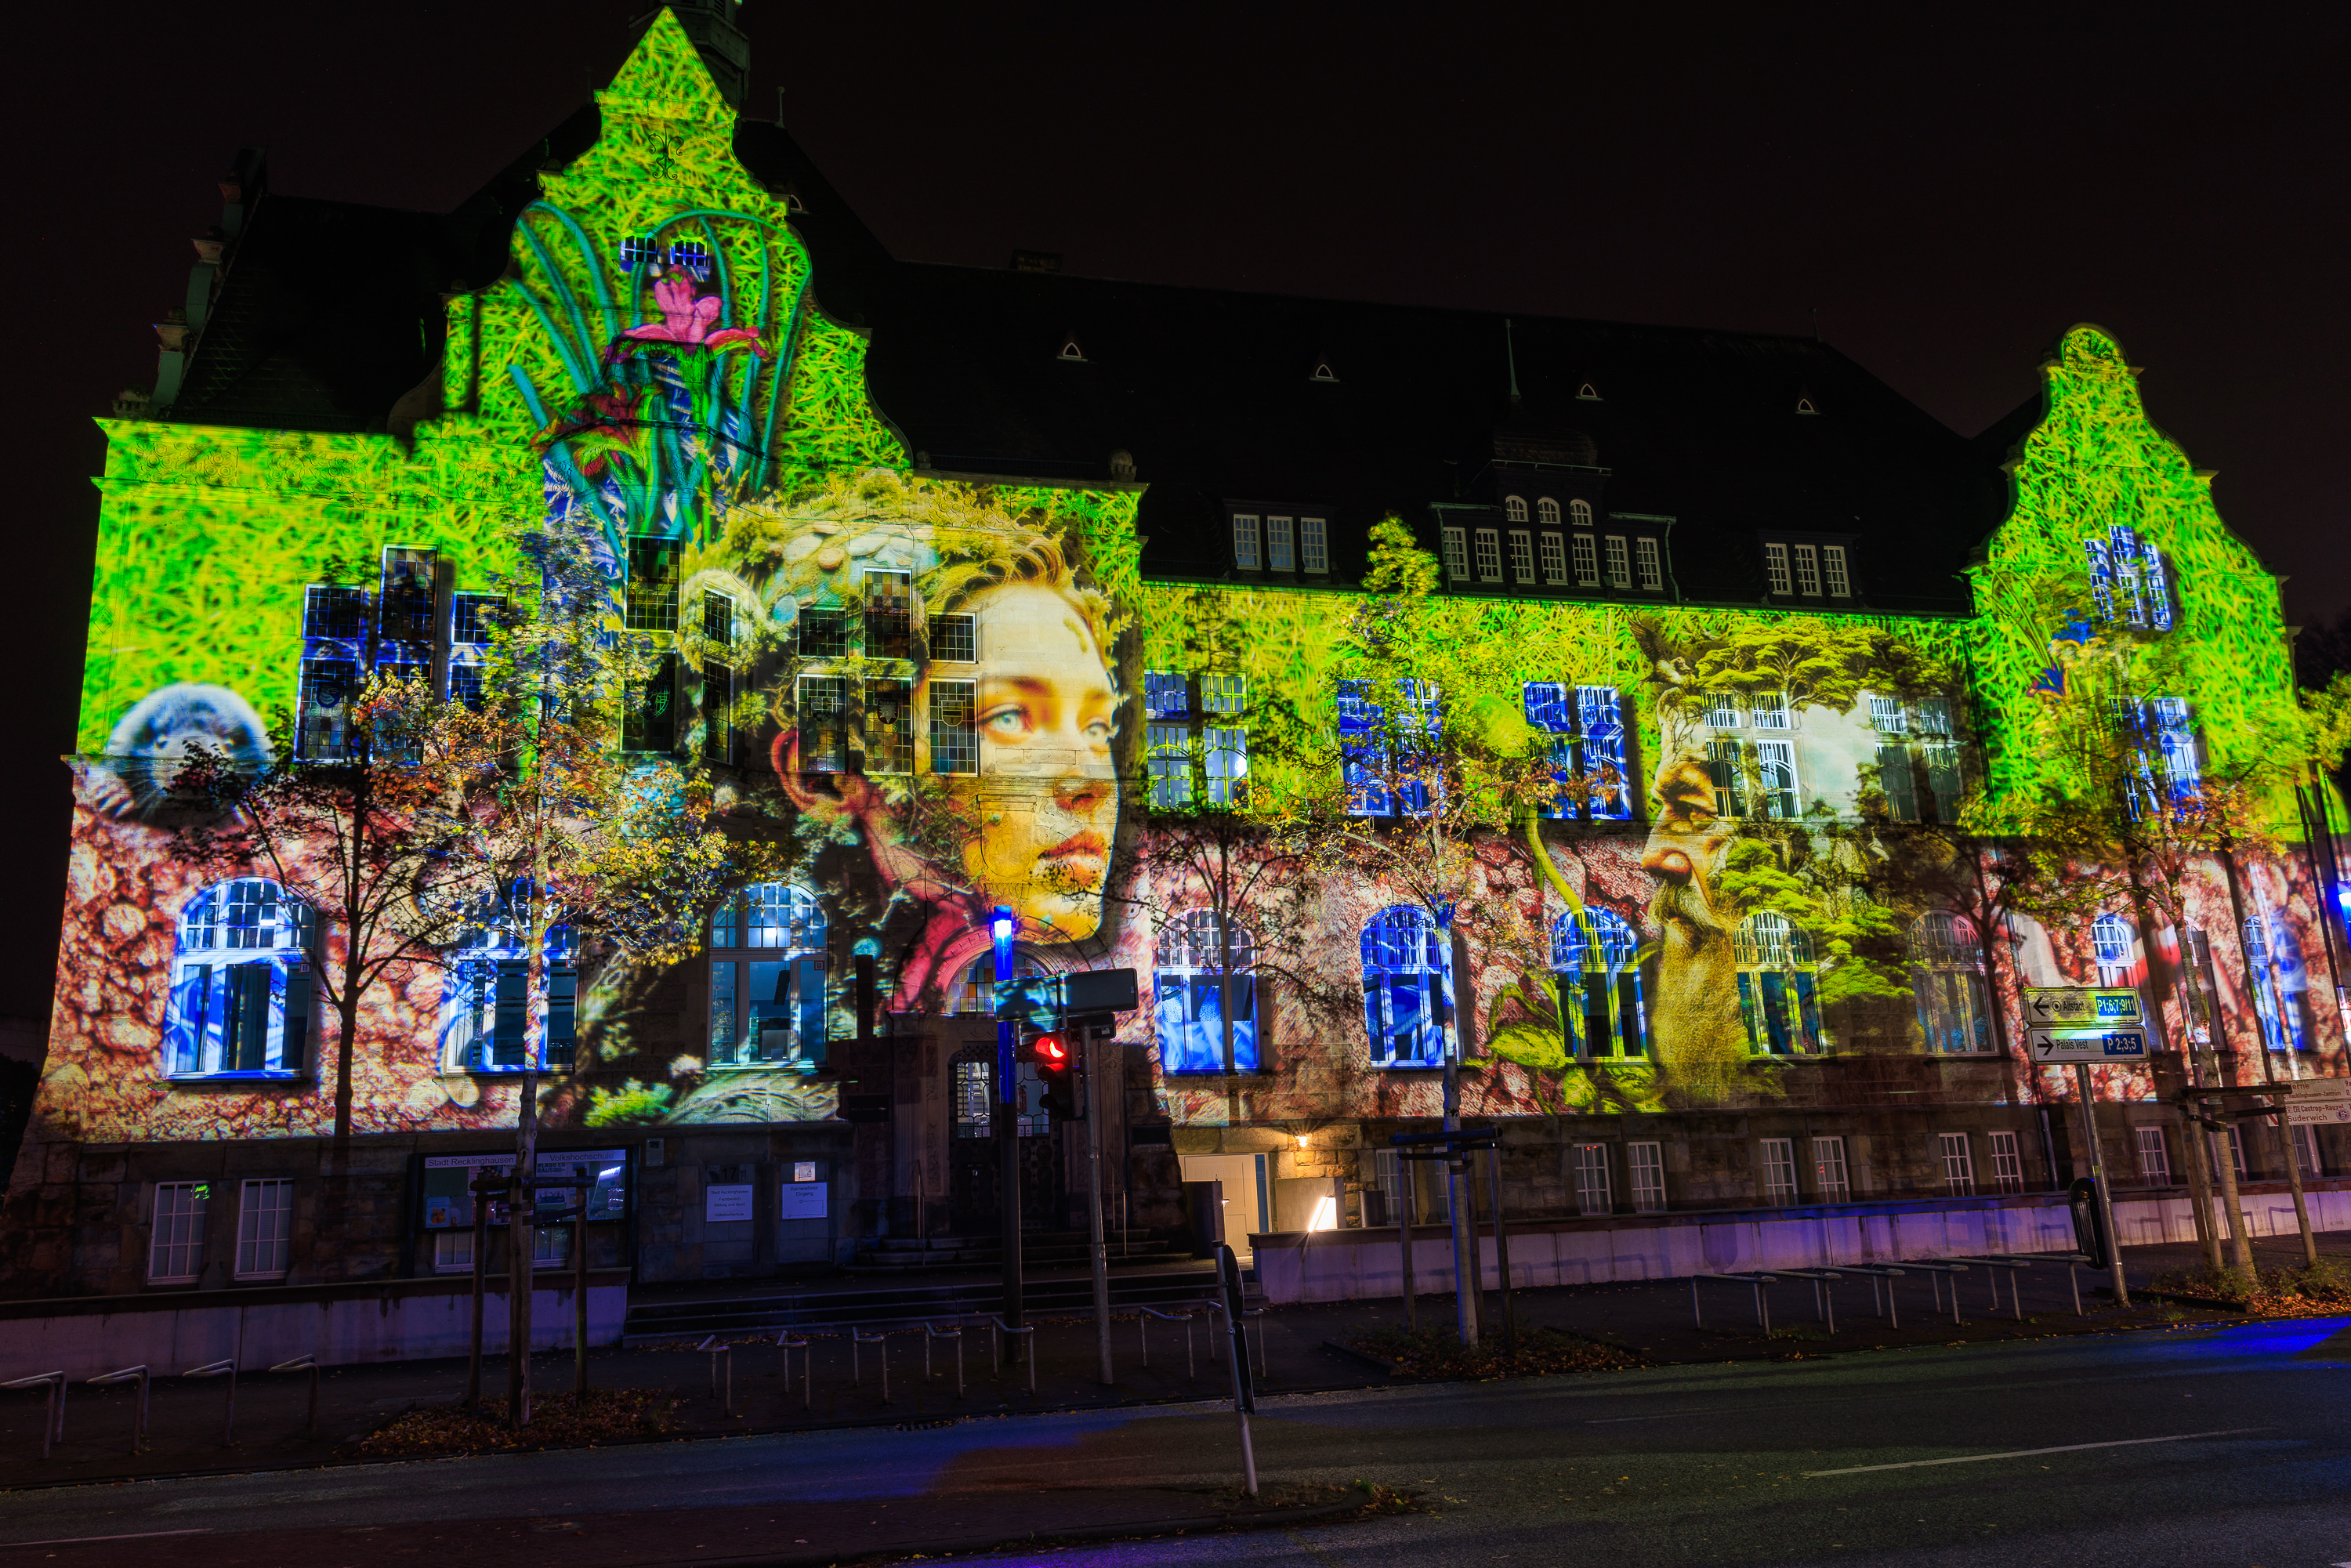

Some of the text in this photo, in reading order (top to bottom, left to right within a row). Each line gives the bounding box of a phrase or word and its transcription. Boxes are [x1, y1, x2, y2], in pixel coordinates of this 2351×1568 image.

[2063, 1001, 2085, 1011] Altstadt
[2056, 1037, 2136, 1052] Palais Vest P 2;3;5
[451, 1157, 514, 1166] Recklinghausen
[549, 1152, 614, 1161] Volkshochschule
[722, 1167, 737, 1180] 17
